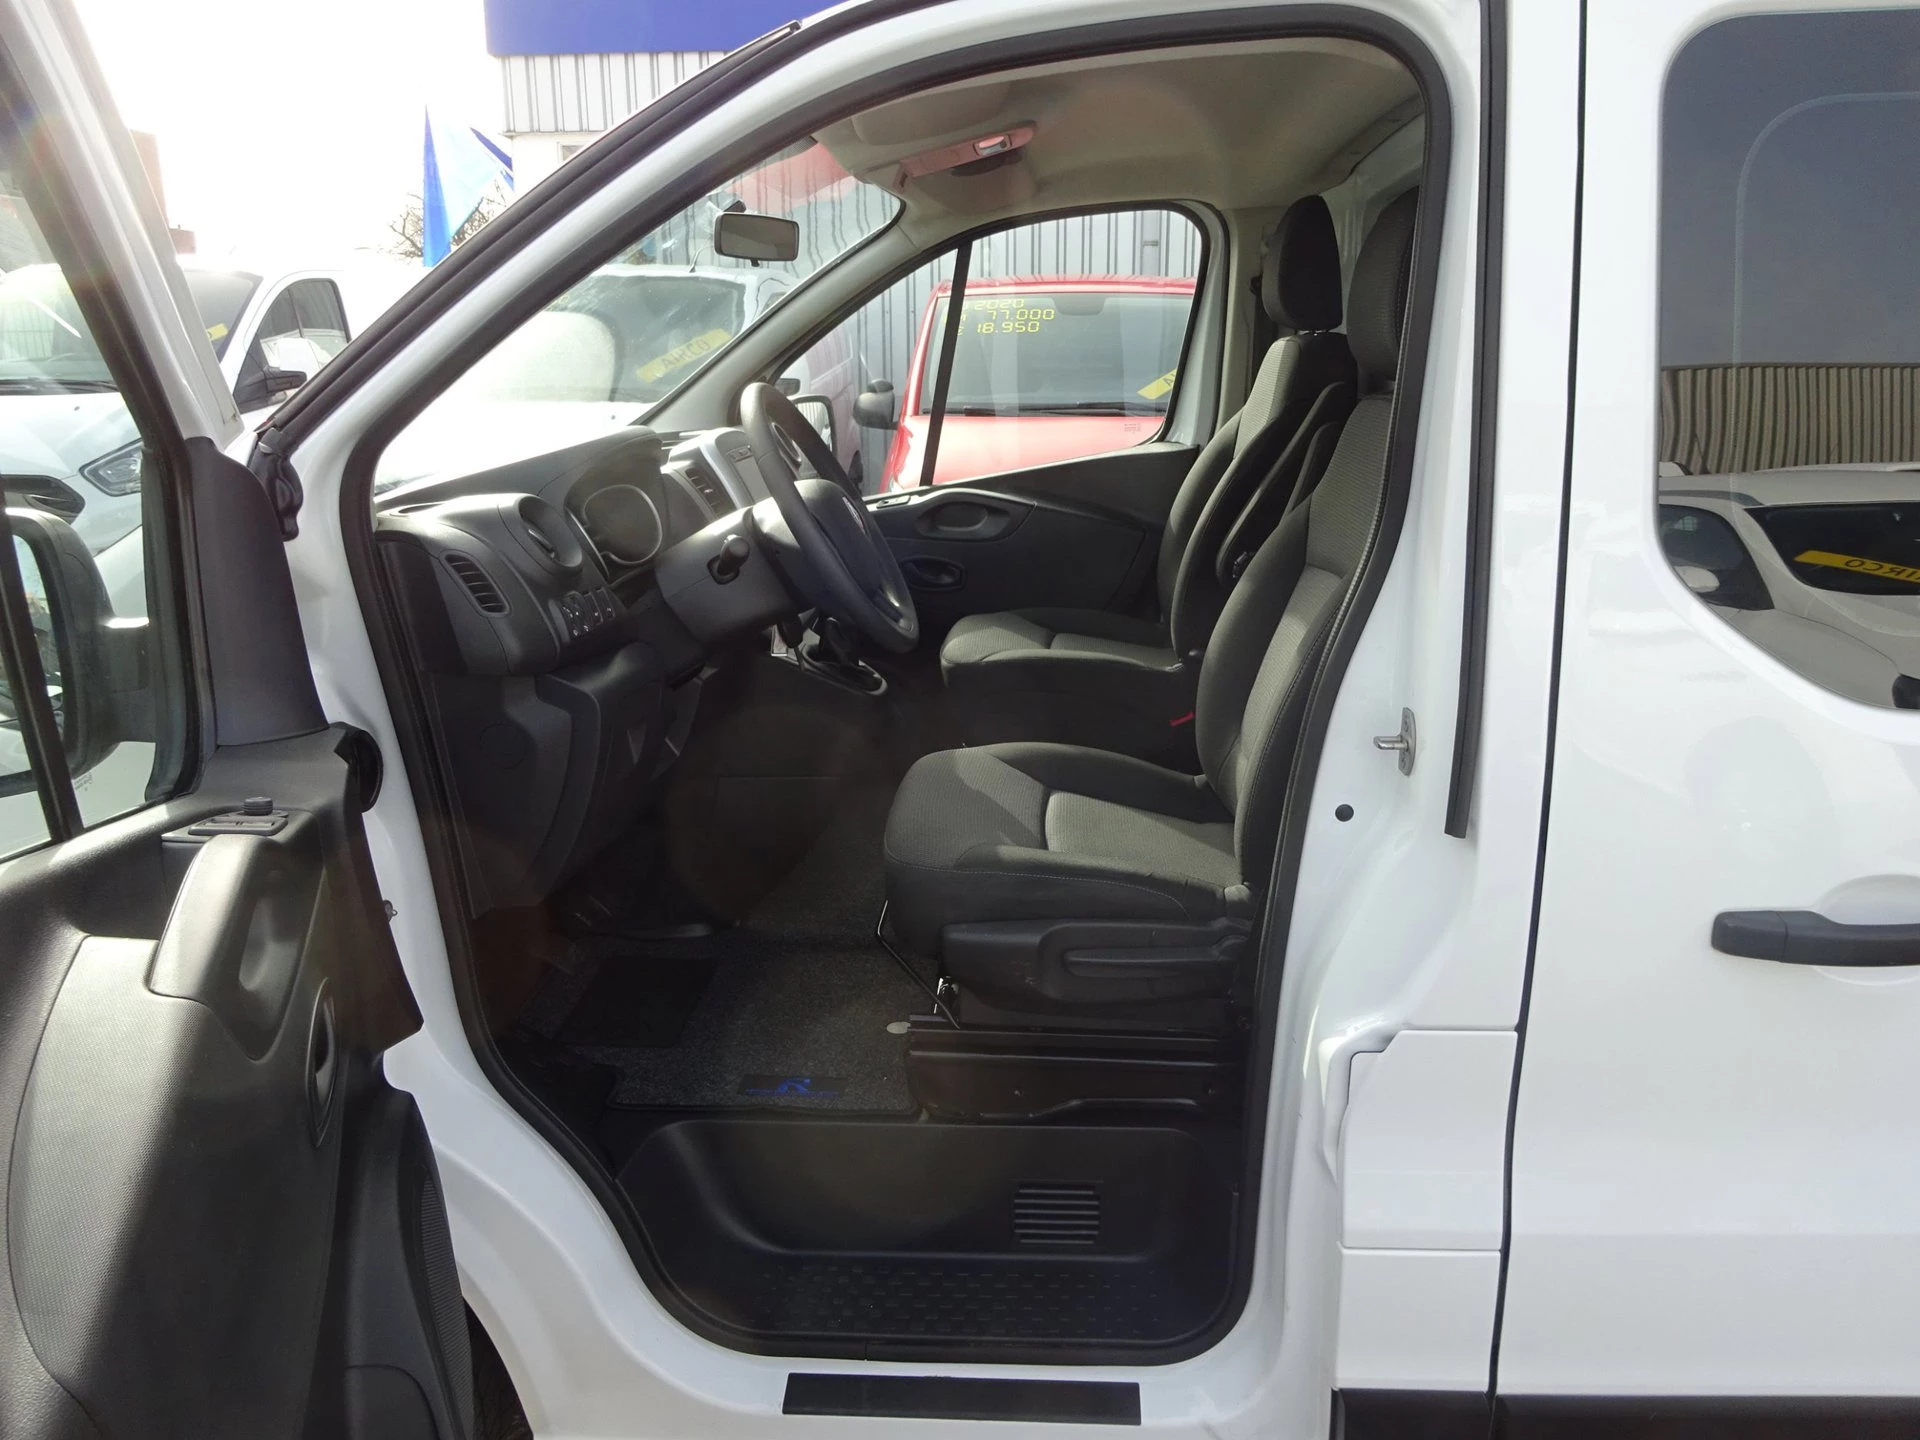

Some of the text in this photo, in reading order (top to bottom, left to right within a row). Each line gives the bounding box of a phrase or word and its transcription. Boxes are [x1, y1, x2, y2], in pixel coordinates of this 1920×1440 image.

[974, 299, 1025, 310] 2020
[987, 309, 1055, 320] 77.000
[976, 321, 1040, 333] 18.950
[661, 338, 711, 368] AIRCO
